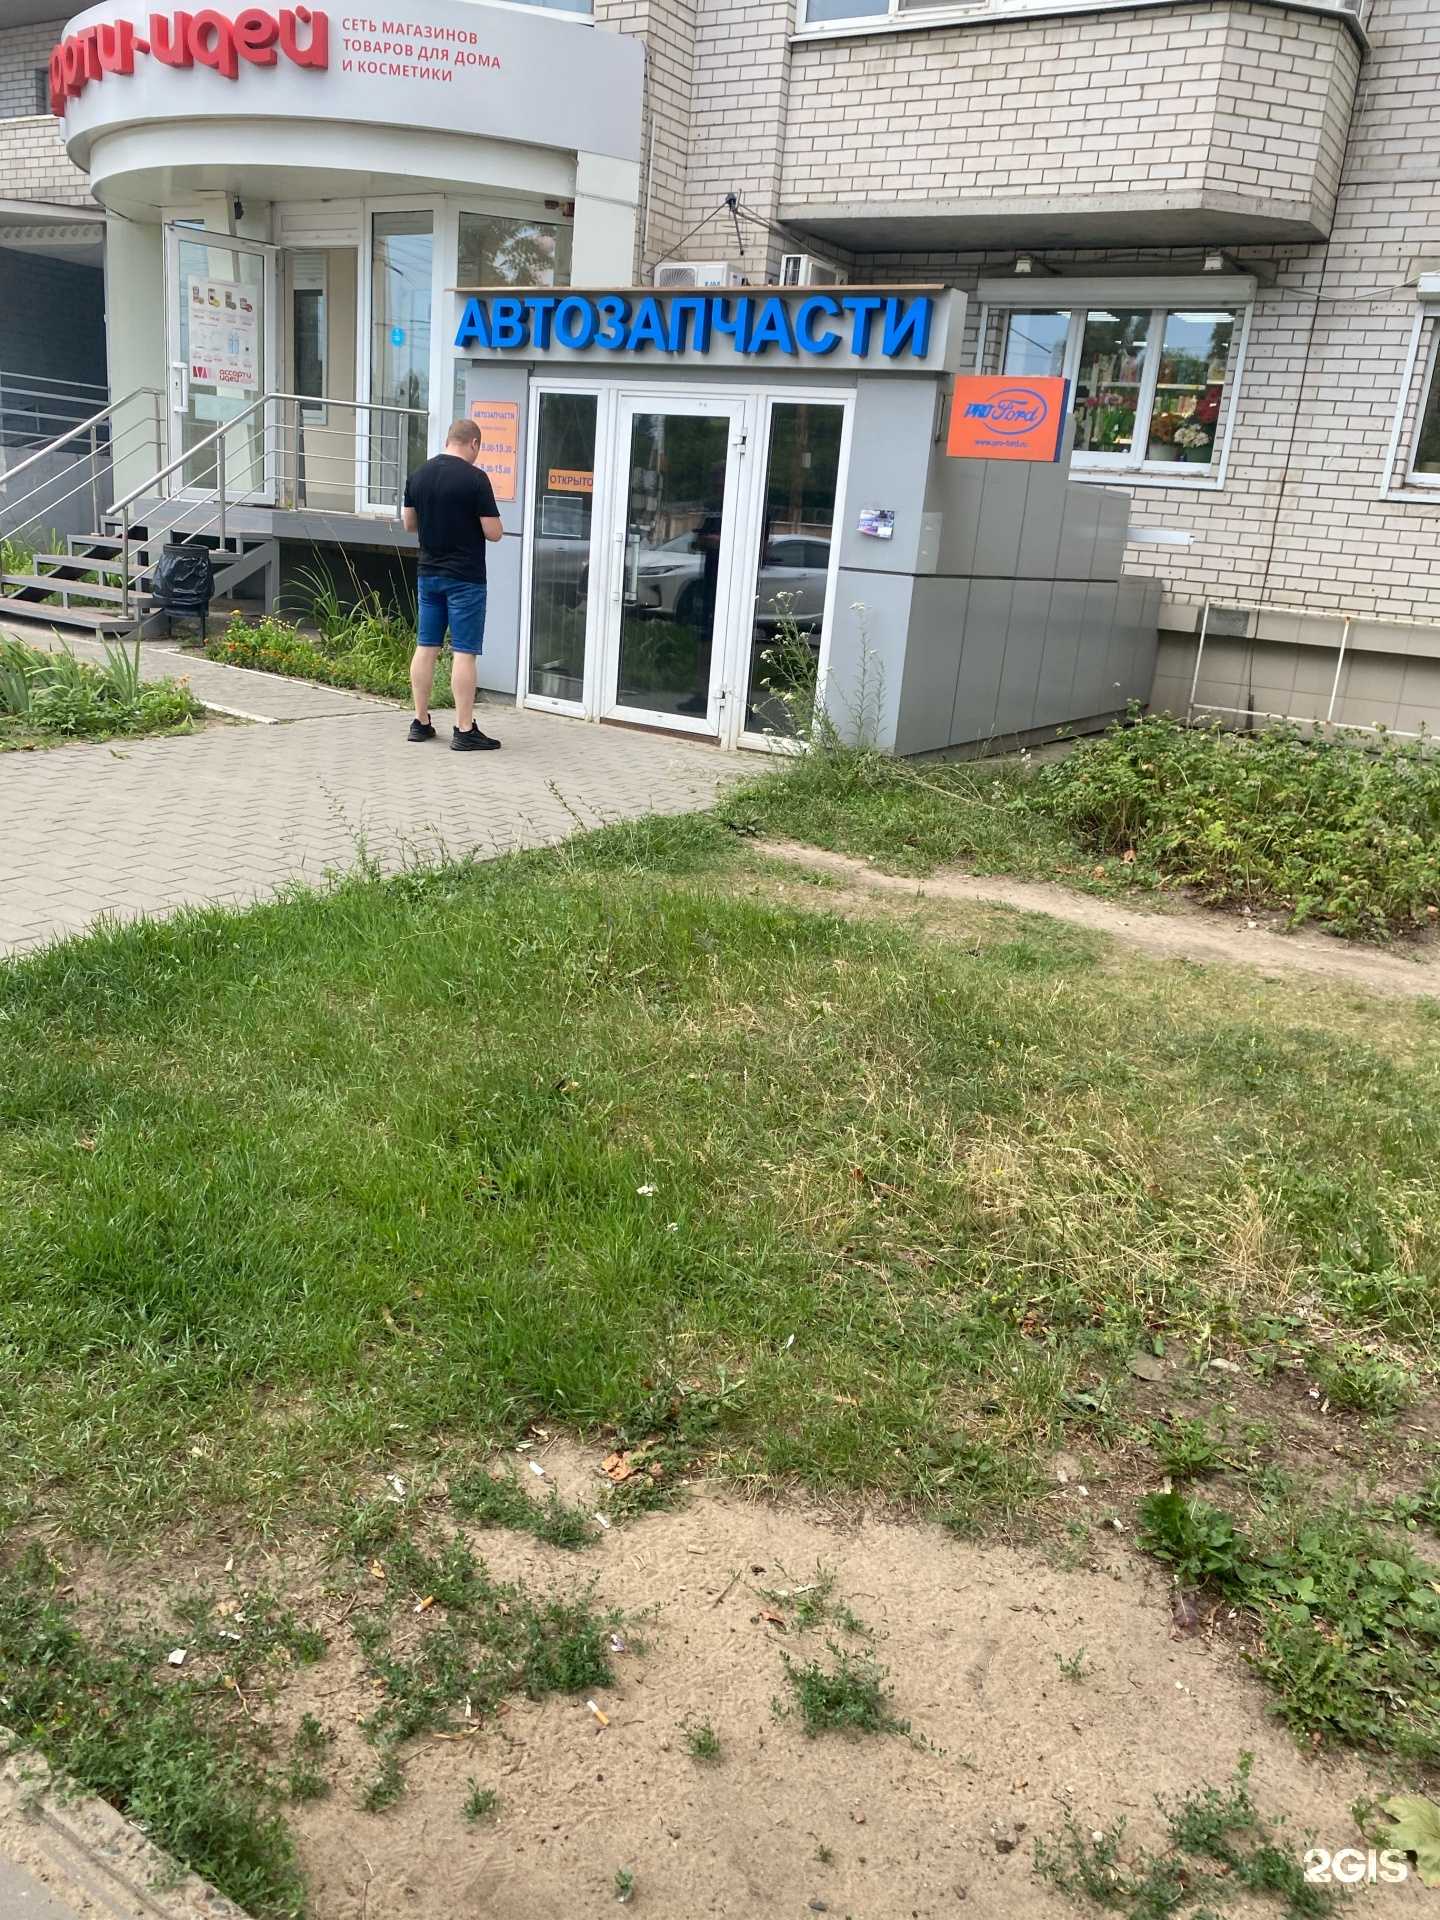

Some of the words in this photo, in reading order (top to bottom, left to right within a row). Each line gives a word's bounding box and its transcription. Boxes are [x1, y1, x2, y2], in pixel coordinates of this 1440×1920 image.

[342, 18, 377, 32] СЕТЬ
[382, 21, 478, 45] МАГАЗИНОВ
[343, 38, 413, 56] ТОВАРОВ
[417, 46, 449, 62] ДЛЯ
[454, 51, 501, 69] ДОМА
[342, 59, 352, 72] И
[358, 60, 453, 82] КОСМЕТИКИ
[454, 295, 933, 359] АВТОЗАПЧАСТИ
